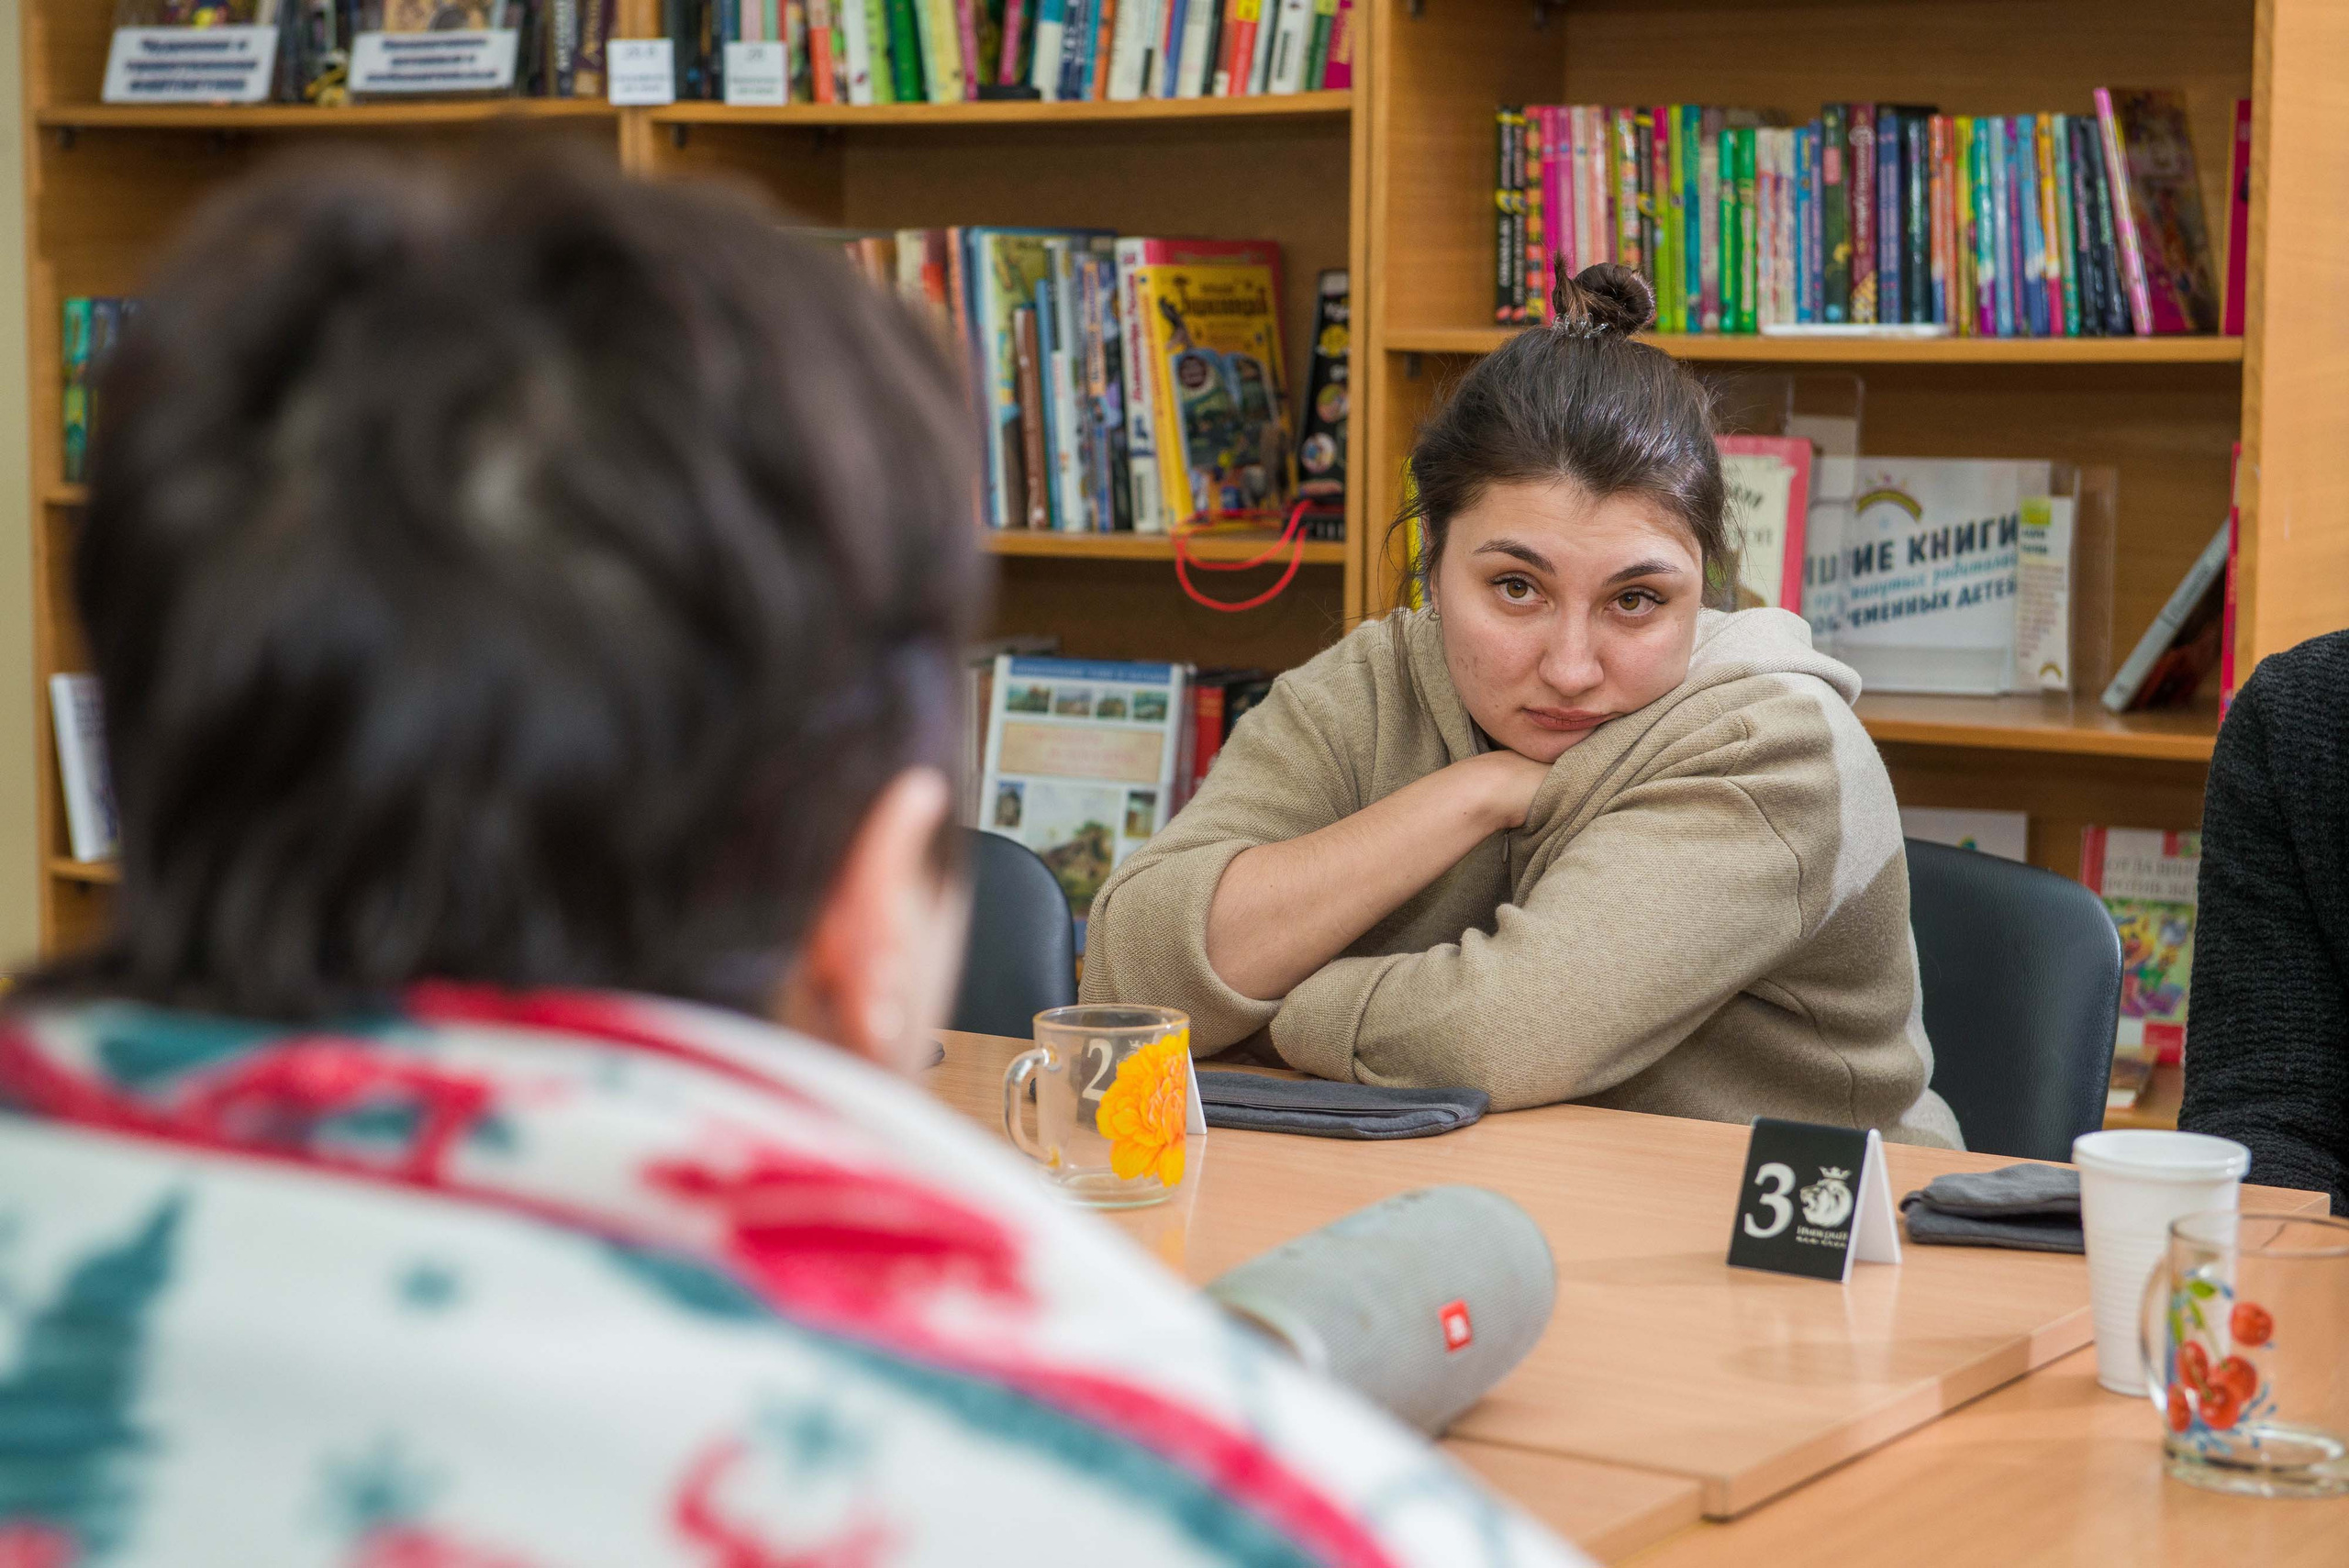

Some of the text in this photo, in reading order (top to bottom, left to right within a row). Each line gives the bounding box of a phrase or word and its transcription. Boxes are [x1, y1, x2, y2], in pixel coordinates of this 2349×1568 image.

[1907, 512, 2018, 565] КНИГИ
[1082, 1038, 1113, 1102] 2
[1743, 1162, 1797, 1239] 3
